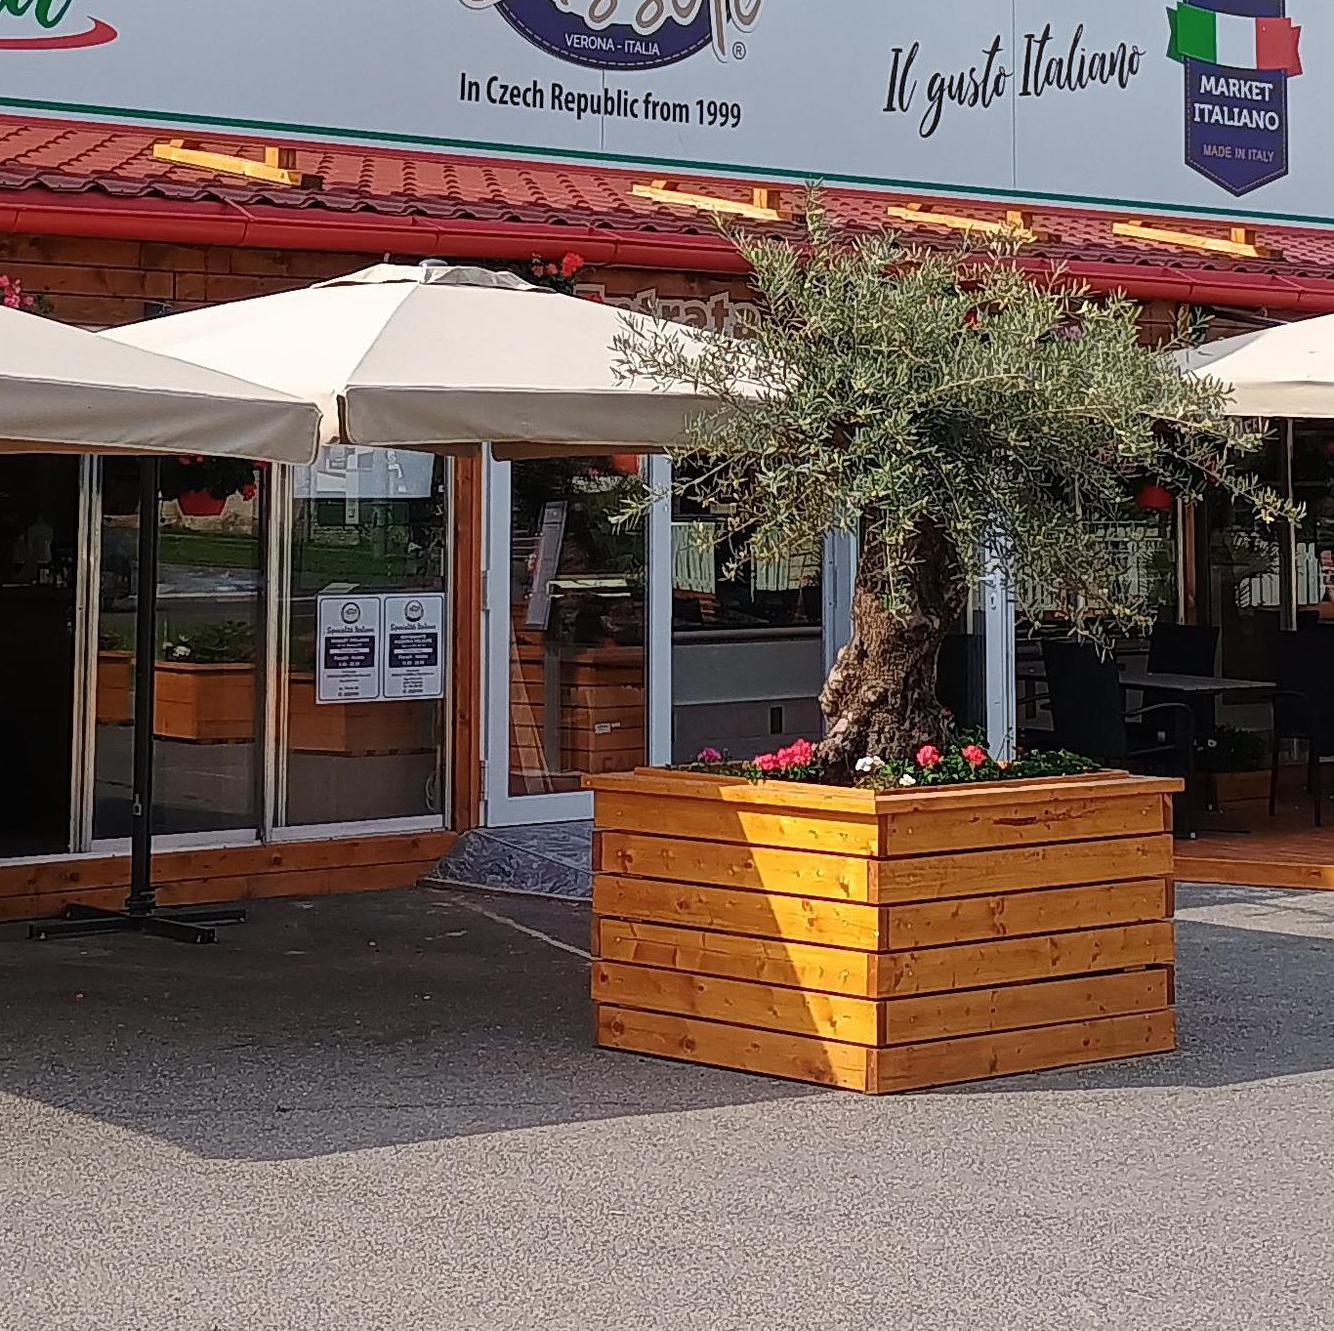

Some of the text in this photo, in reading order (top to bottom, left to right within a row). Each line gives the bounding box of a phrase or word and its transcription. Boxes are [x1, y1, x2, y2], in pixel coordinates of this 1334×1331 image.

[564, 33, 615, 52] VERONA
[624, 40, 661, 56] ITALIA
[882, 23, 1147, 139] Il gusto Italiano
[1199, 75, 1274, 102] MARKET
[459, 72, 742, 129] In Czech Republic from 1999
[1193, 102, 1280, 131] ITALIANO
[1202, 144, 1275, 163] MADE IN ITALY
